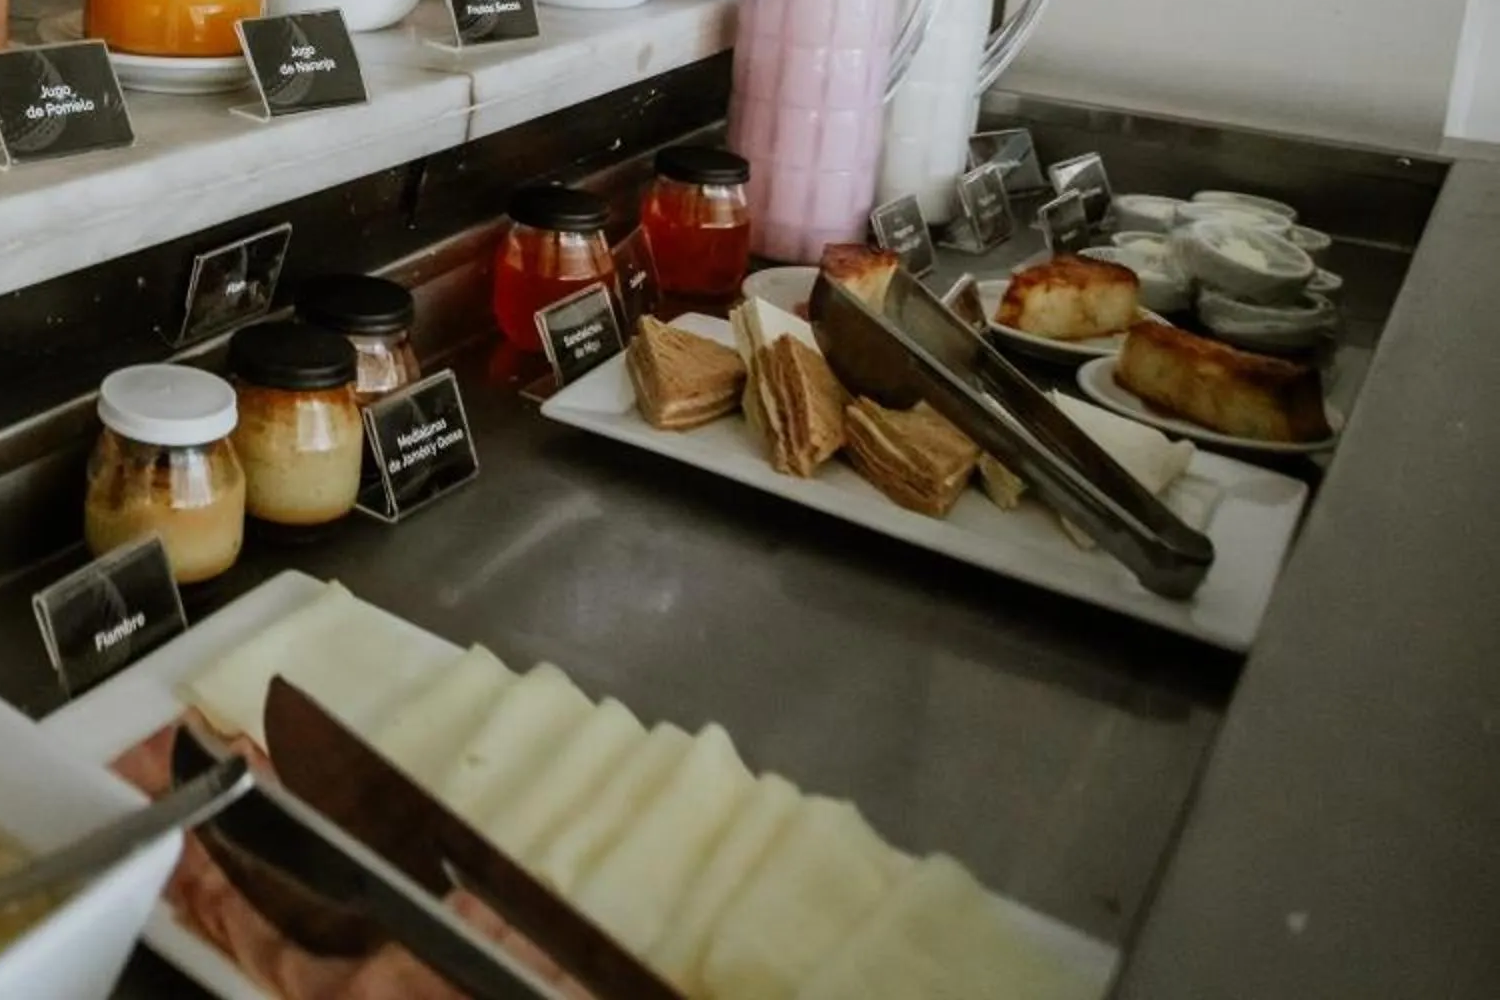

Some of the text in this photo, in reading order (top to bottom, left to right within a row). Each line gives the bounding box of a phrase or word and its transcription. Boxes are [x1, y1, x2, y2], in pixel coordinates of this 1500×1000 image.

[291, 45, 315, 59] Jugo
[280, 63, 295, 75] de
[40, 84, 72, 100] Jugo
[26, 105, 45, 119] de
[94, 611, 146, 652] Fiambre
